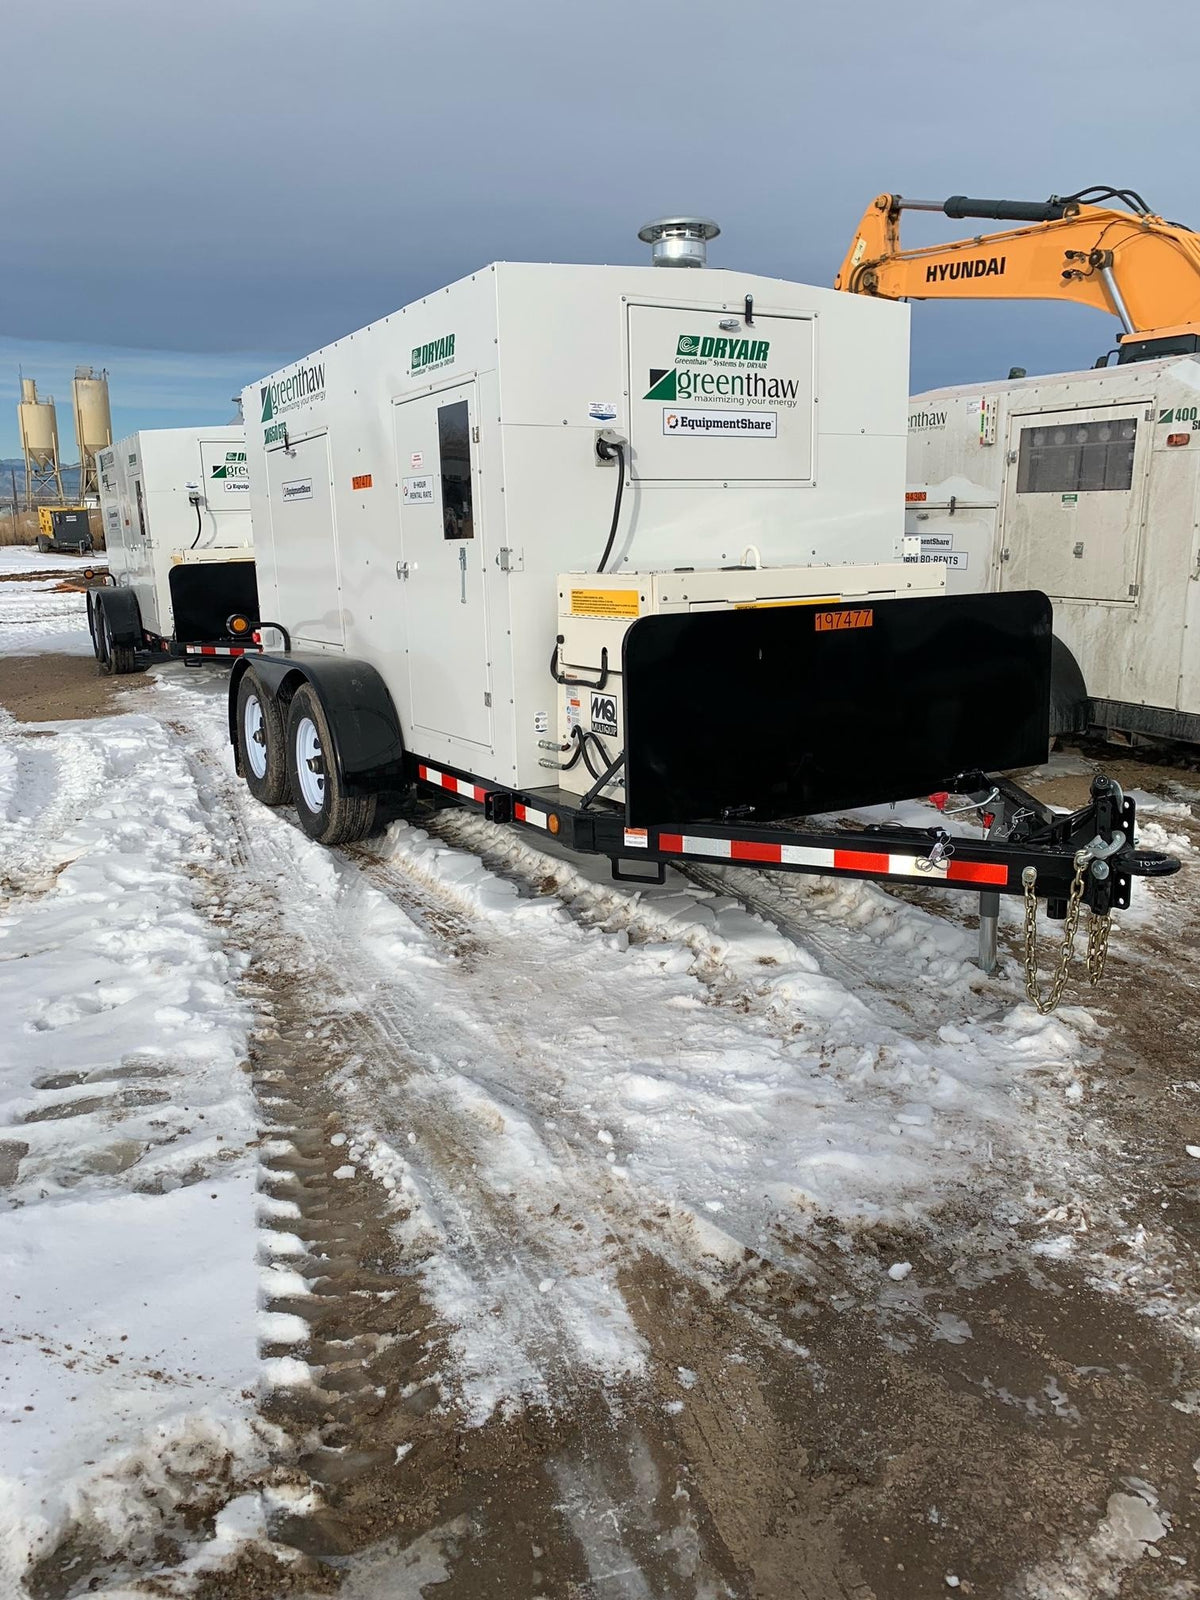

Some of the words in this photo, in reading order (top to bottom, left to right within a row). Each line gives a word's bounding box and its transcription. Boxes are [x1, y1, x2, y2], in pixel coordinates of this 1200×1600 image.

[926, 257, 1006, 283] HYUNDAI
[422, 333, 455, 366] DRYAIR
[700, 336, 770, 361] DRYAIR
[713, 360, 737, 368] Systems
[738, 361, 745, 369] by
[271, 362, 326, 415] greenthaw
[677, 369, 800, 400] greenthaw
[694, 395, 745, 406] maximizing
[746, 397, 766, 407] your
[768, 399, 798, 409] energy
[680, 416, 772, 431] EquipmentShare
[908, 411, 948, 428] nthaw
[1175, 406, 1198, 422] 400
[816, 610, 872, 630] 197477
[591, 697, 617, 724] MQ
